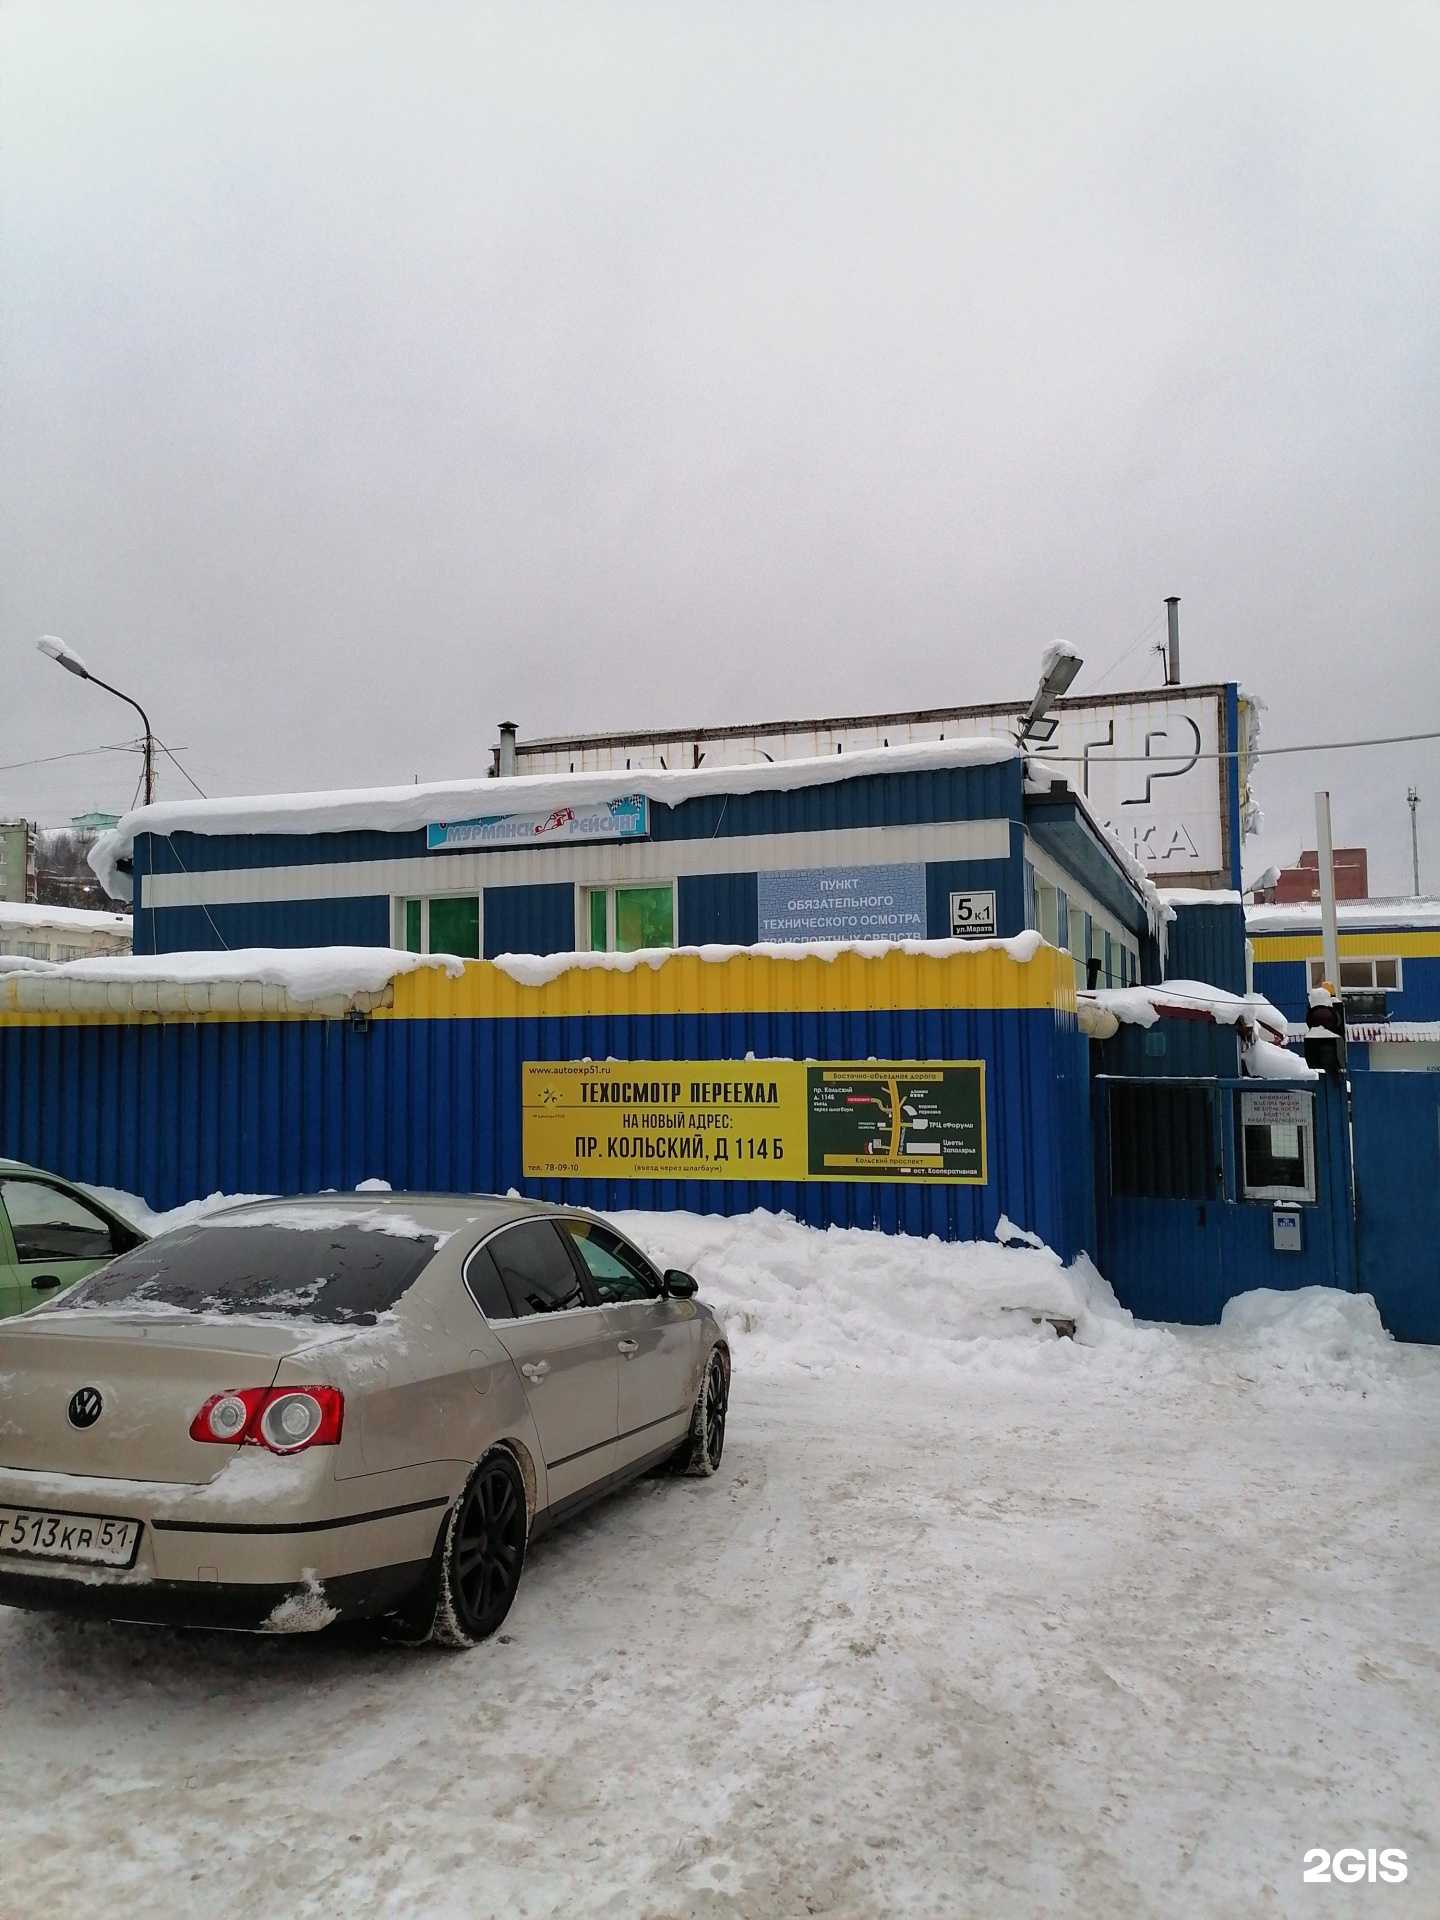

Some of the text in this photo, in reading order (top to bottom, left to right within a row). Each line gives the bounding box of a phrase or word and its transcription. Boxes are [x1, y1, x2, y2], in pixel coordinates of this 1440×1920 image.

[447, 813, 639, 842] МУРМАНСК РЕЙСИНГ
[820, 878, 859, 891] ПУНКТ
[787, 895, 894, 911] ОБЯЗАТЕЛЬНОГО
[763, 913, 921, 930] ТЕХНИЧЕСКОГО ОСМОТРА
[528, 1065, 611, 1076] www.autoexp51.ru
[580, 1082, 778, 1104] ТЕХОСМОТР ПЕРЕЕХАЛ
[623, 1111, 734, 1130] НА НОВЫЙ АДРЕС:
[575, 1136, 603, 1158] ПР.
[607, 1134, 710, 1162] КОЛЬСКИЙ,
[714, 1137, 729, 1161] Д
[544, 1163, 579, 1172] 78-09-10
